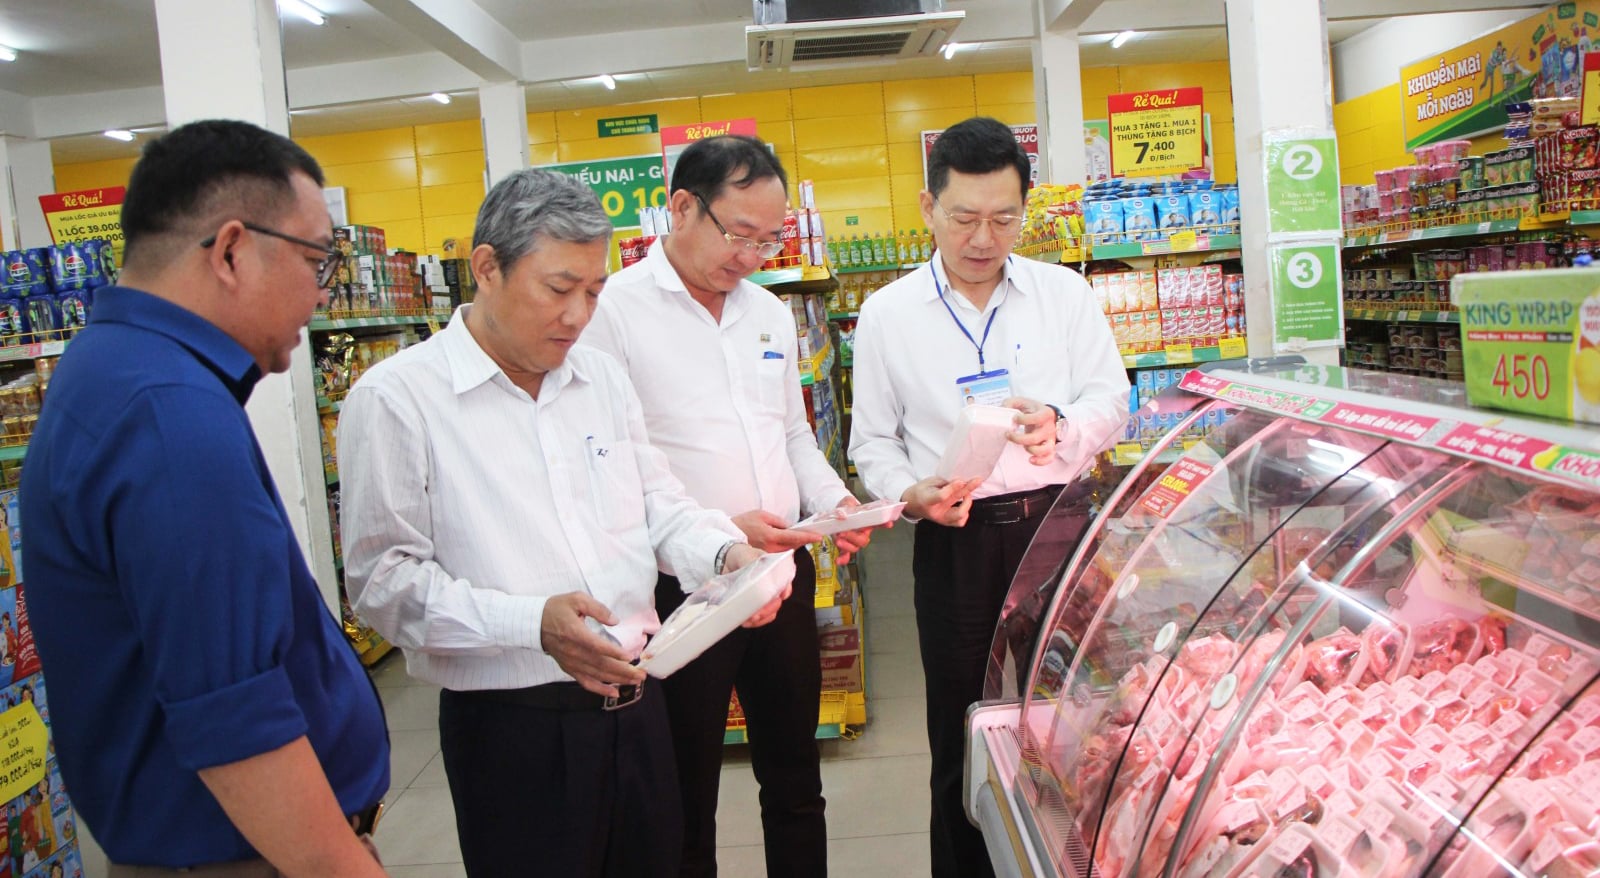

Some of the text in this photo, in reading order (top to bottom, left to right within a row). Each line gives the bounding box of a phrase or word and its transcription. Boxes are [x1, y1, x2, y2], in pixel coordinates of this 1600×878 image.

[1133, 90, 1178, 107] Rẻ Quá!
[1440, 87, 1473, 114] NGÀY
[686, 126, 702, 139] Rẻ
[1291, 151, 1314, 175] 2
[570, 167, 601, 184] IẾU
[606, 168, 634, 185] NẠI
[62, 190, 102, 207] Rẻ Quá!
[632, 186, 668, 214] 10
[65, 224, 86, 236] LỐC
[1296, 258, 1314, 282] 3
[1466, 300, 1511, 326] KING
[1516, 300, 1573, 326] WRAP
[1492, 353, 1550, 400] 450
